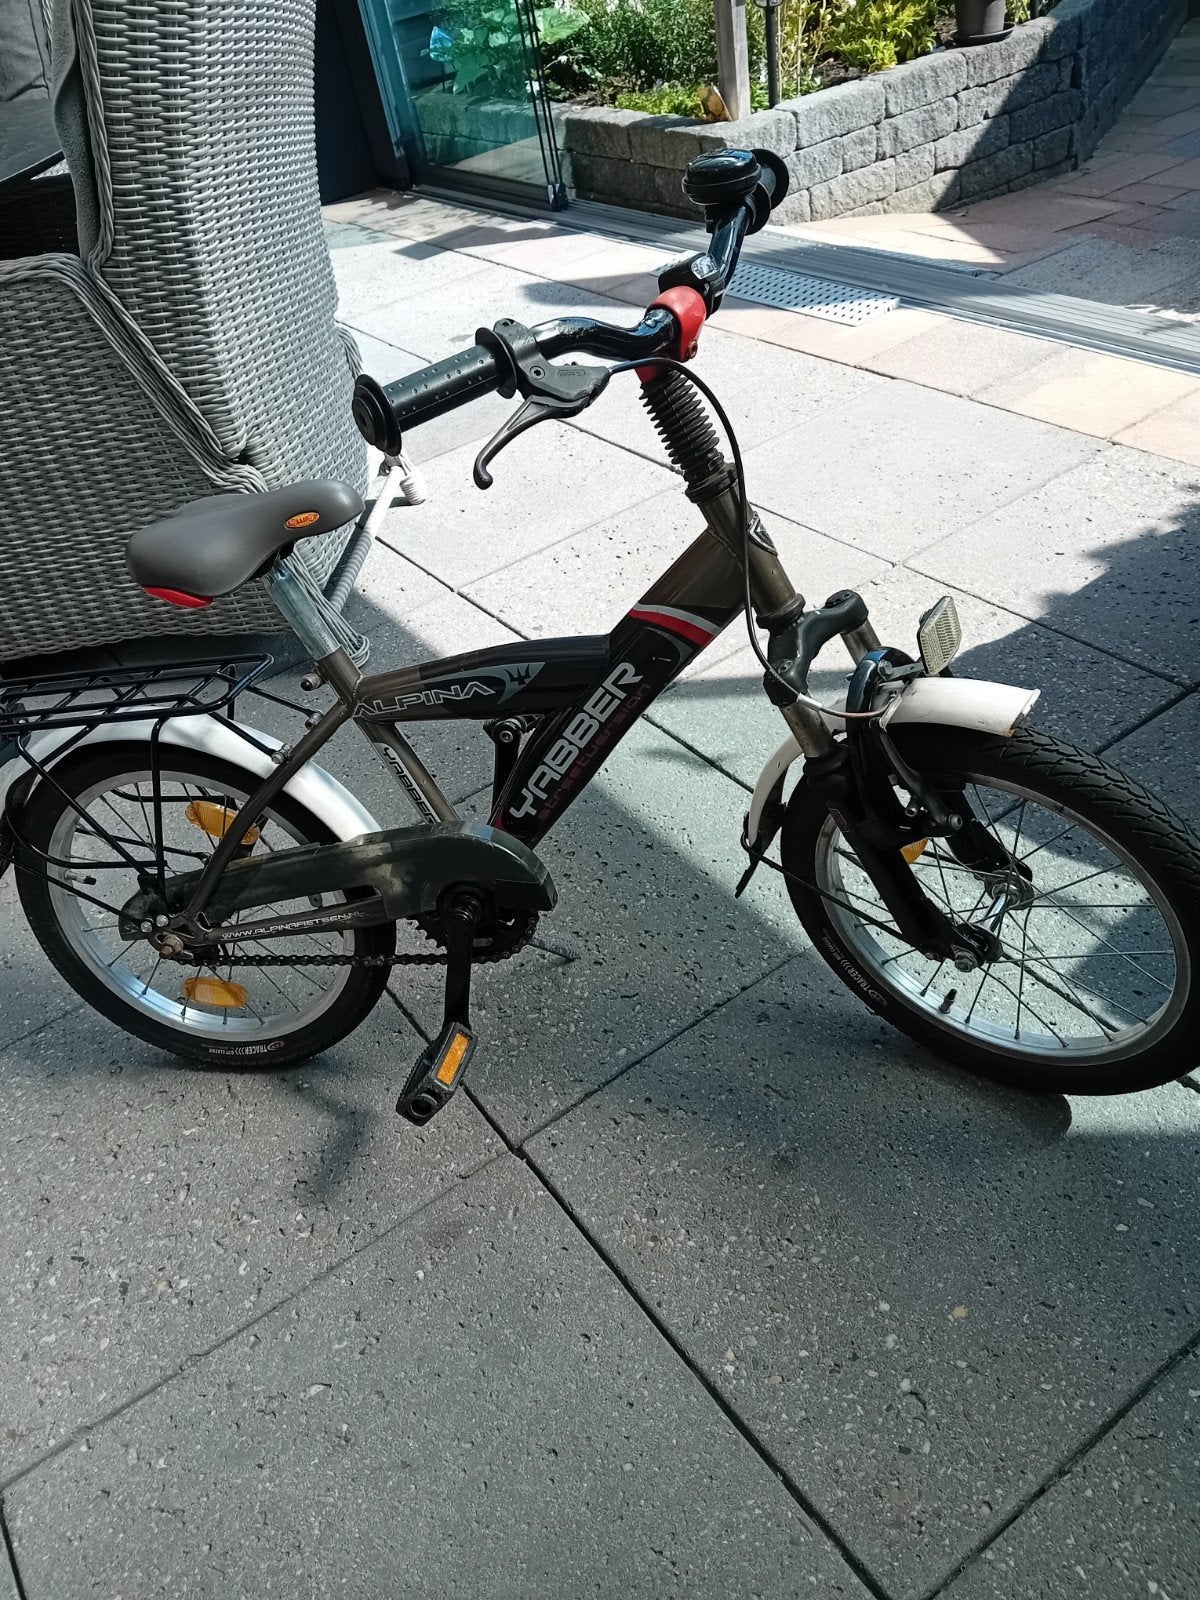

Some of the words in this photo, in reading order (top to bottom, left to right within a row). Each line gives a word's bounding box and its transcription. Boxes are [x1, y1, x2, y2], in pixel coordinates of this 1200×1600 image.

[352, 681, 496, 718] ALPINA
[509, 662, 643, 818] YABBER
[383, 746, 438, 824] YABBER
[847, 966, 871, 991] TRACER
[244, 1044, 268, 1055] TRACER
